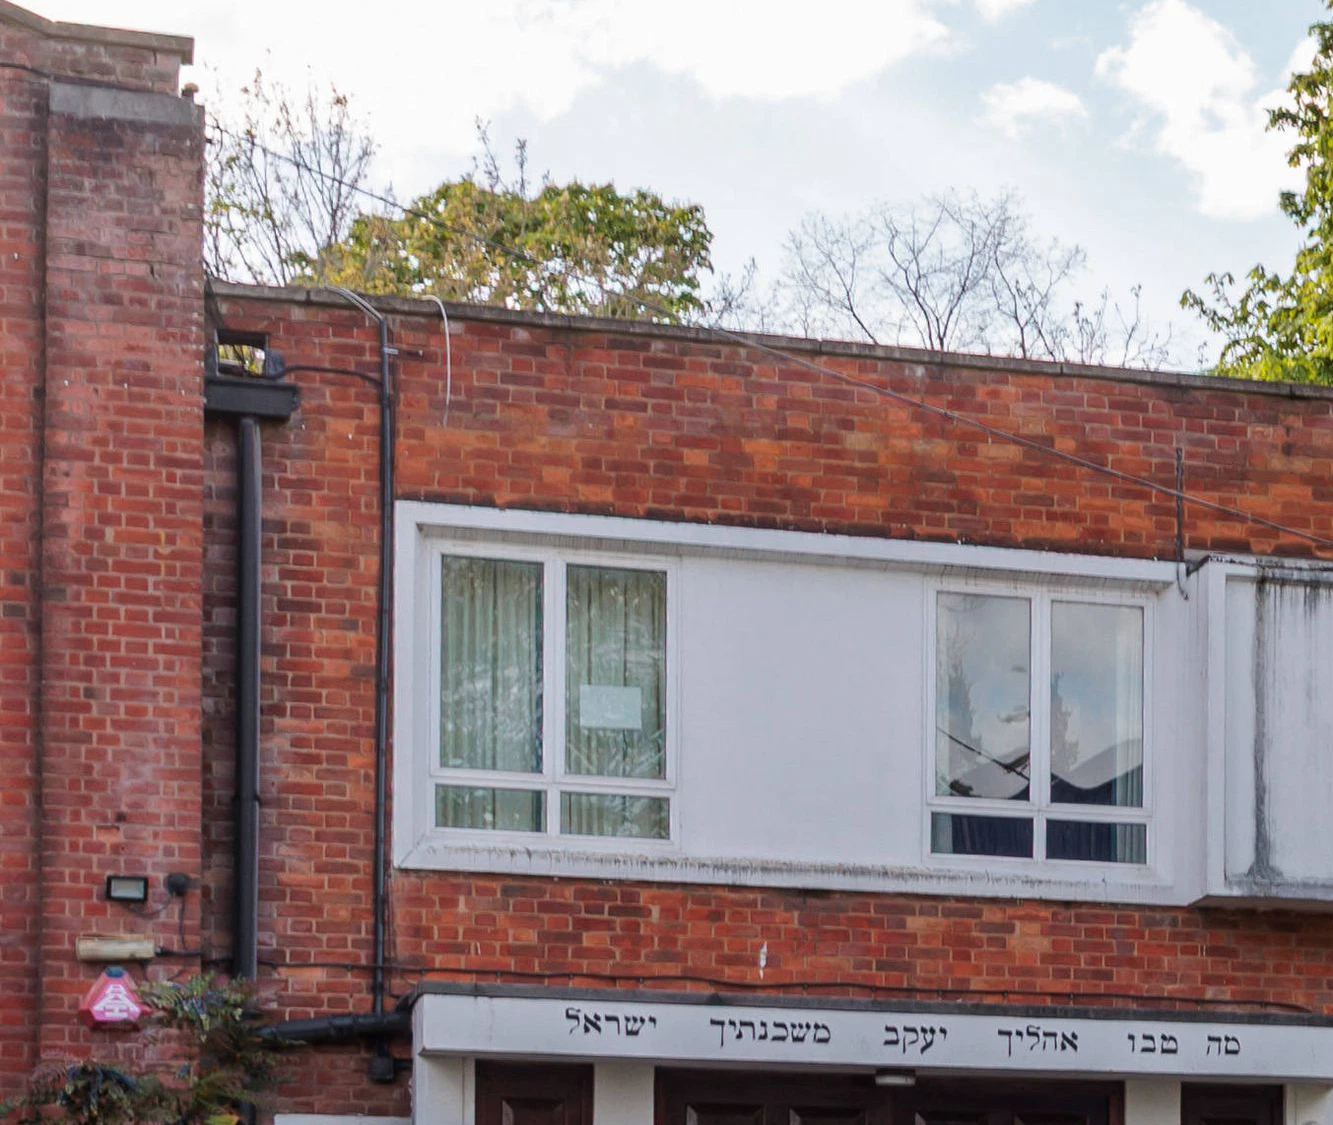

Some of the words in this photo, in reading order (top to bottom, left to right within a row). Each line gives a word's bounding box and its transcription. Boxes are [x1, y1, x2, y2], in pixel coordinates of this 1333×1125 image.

[565, 1006, 657, 1037] ישראל
[709, 1016, 832, 1048] משכנתיך
[883, 1024, 948, 1054] יעקב
[997, 1025, 1079, 1057] אהליך
[1206, 1034, 1241, 1057] מה
